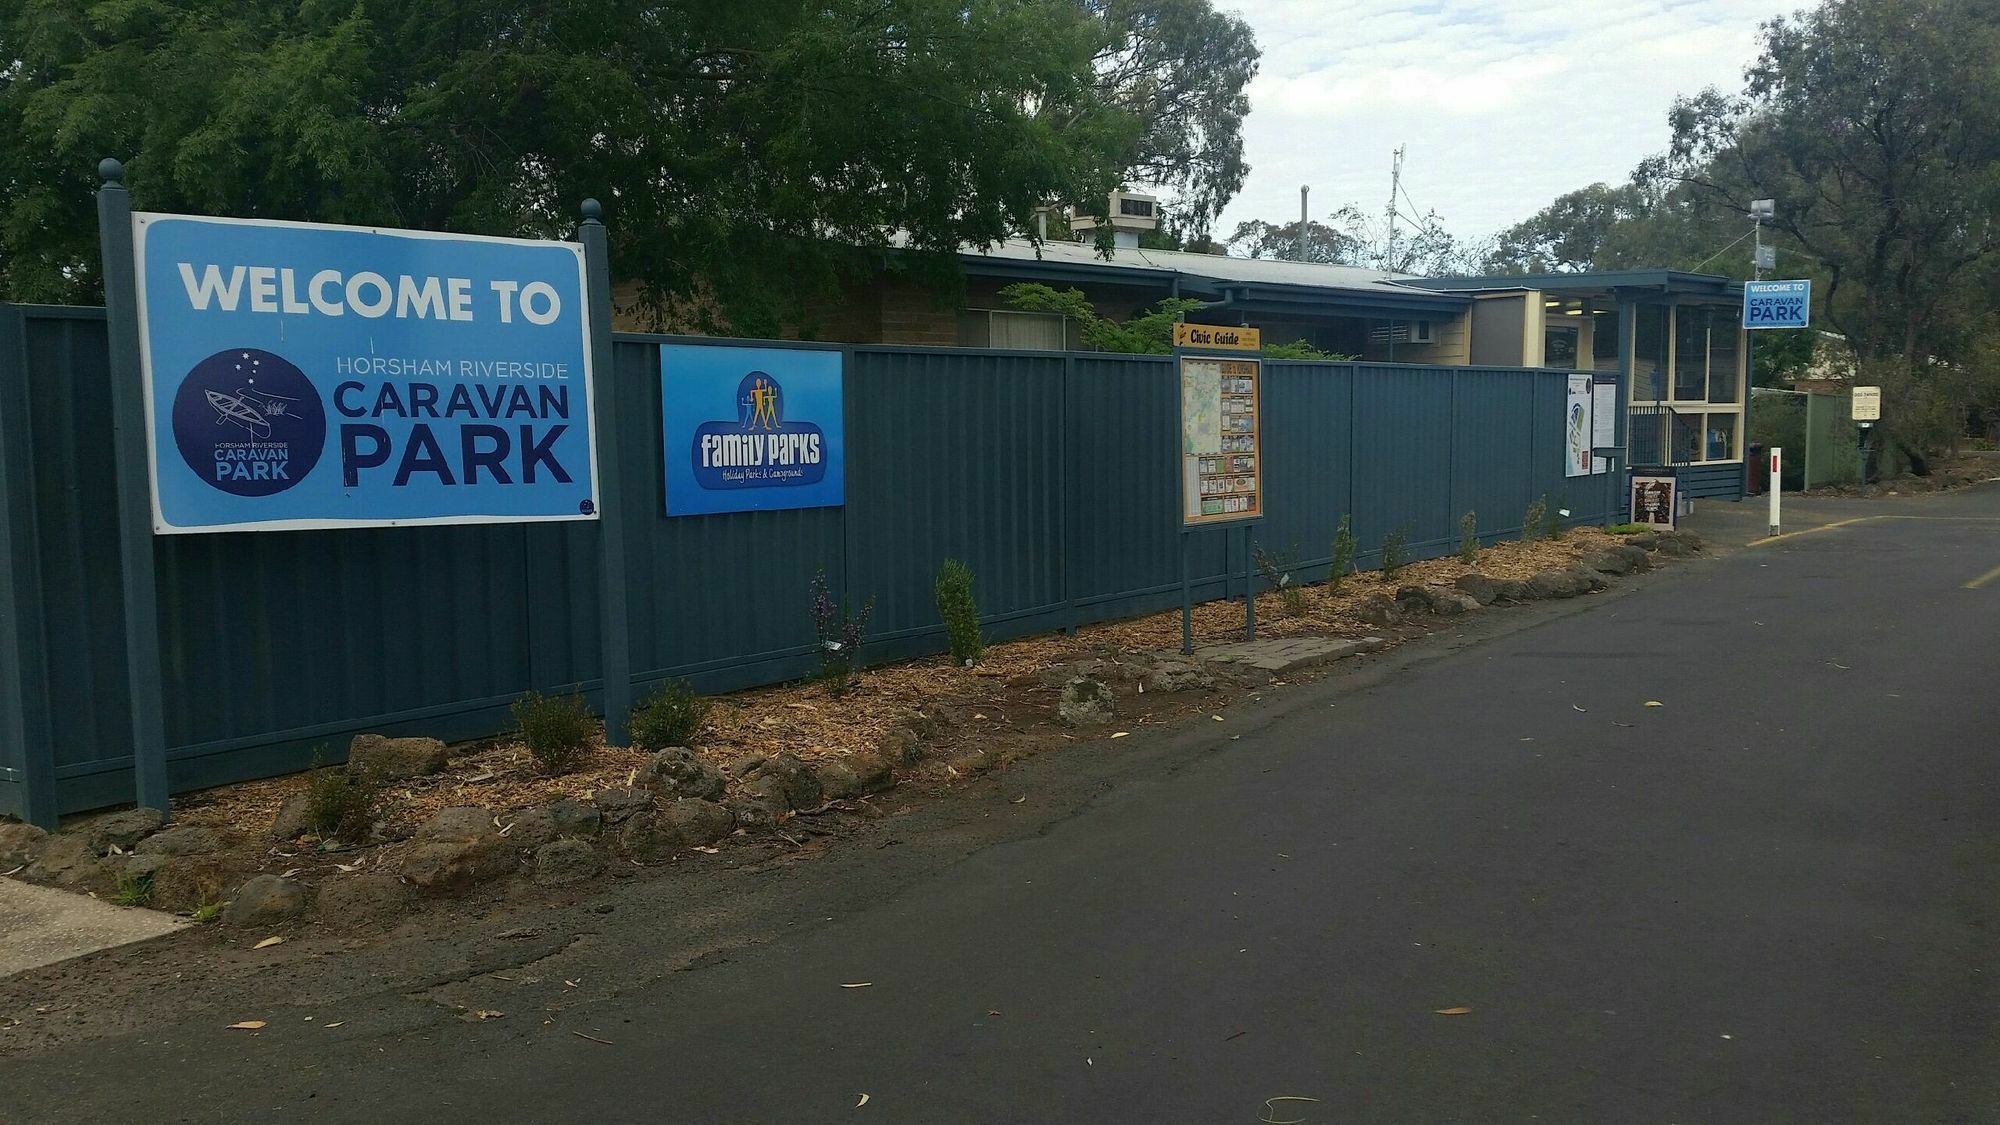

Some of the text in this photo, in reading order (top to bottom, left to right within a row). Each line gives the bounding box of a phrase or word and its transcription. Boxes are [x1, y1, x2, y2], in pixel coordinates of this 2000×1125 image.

[177, 262, 562, 326] WELCOME TO
[1751, 298, 1803, 306] CARAVAN
[1751, 306, 1803, 321] PARK
[1191, 329, 1211, 344] Civic
[1214, 331, 1239, 345] Guide
[336, 356, 569, 380] HORSHAM RIVERSIDE
[333, 381, 569, 418] CARAVAN
[214, 449, 288, 460] CARAVAN
[340, 423, 574, 487] PARK
[215, 460, 291, 481] PARK
[723, 469, 744, 483] Holiday
[745, 469, 761, 479] Parks
[762, 468, 768, 478] &
